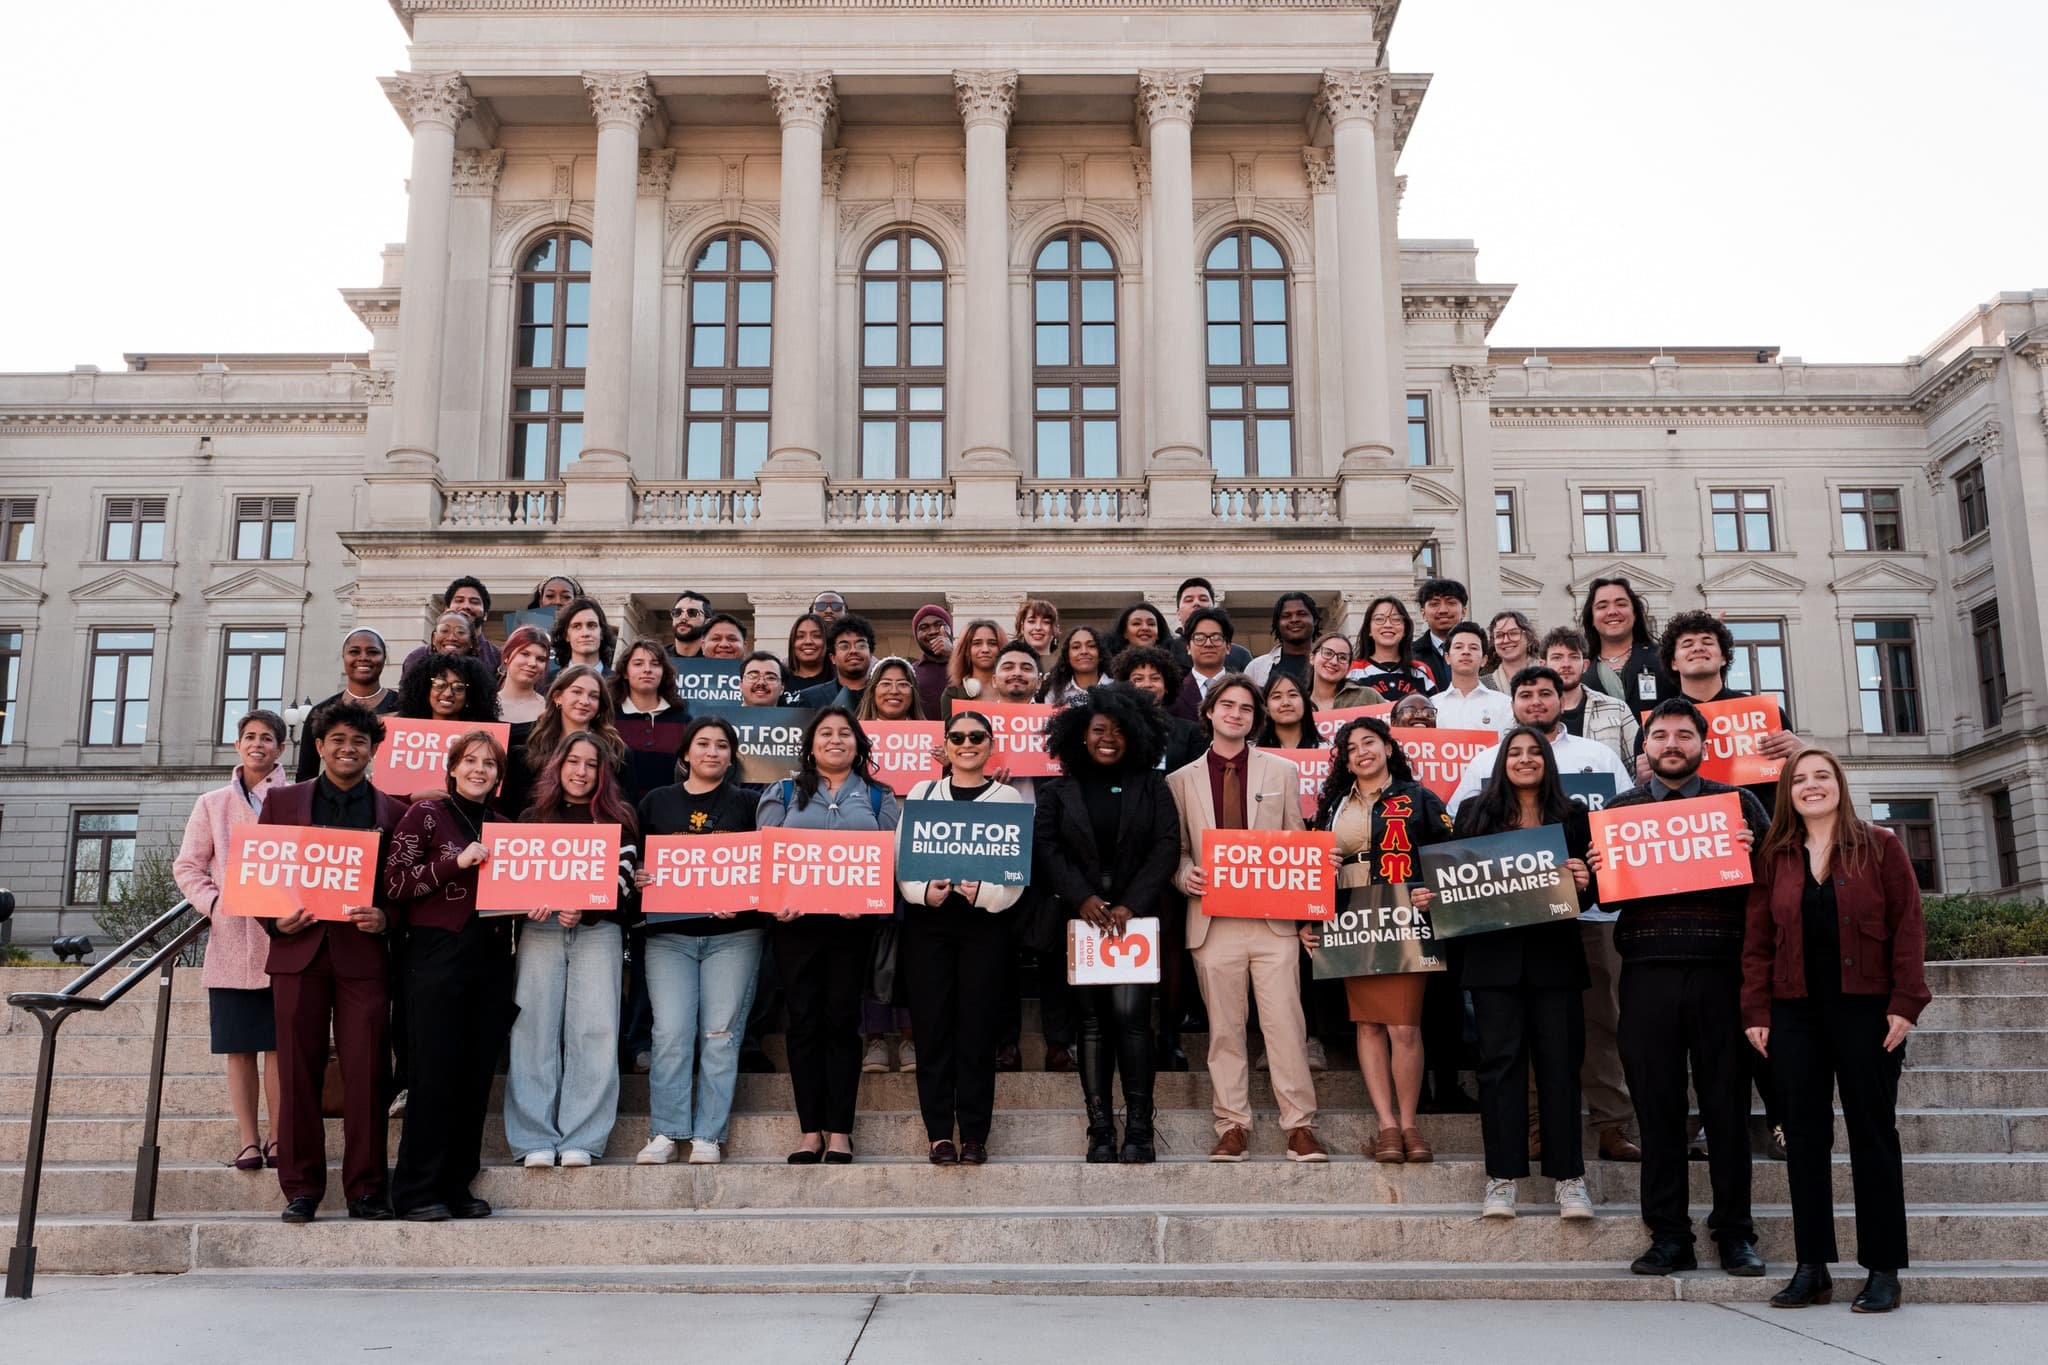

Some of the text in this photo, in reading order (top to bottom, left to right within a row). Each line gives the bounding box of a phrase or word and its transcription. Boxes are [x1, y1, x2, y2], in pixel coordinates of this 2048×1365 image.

[717, 674, 742, 689] FO
[678, 689, 744, 700] ILLIONAIR
[1712, 711, 1767, 735] OUR
[392, 731, 441, 749] FOR
[759, 726, 803, 743] FOR
[885, 733, 933, 750] OUR
[992, 733, 1052, 753] TUR
[738, 743, 803, 756] ONAIRES
[1397, 741, 1436, 759] OR
[871, 752, 932, 771] TURE
[1297, 761, 1330, 776] UR
[1407, 761, 1470, 782] UTU
[913, 821, 1021, 843] NOT FOR
[1604, 811, 1729, 845] FOR OUR
[242, 839, 364, 866] FOR OUR
[494, 838, 607, 857] FOR OUR
[657, 845, 761, 865] FOR OUR
[773, 842, 881, 863] FOR OUR
[912, 841, 1021, 857] BILLIONAIRES
[1214, 844, 1322, 866] FOR OUR
[1607, 833, 1733, 870] FUTURE
[239, 862, 361, 892] FUTURE
[492, 859, 606, 881] FUTURE
[656, 864, 760, 887] FUTURE
[772, 863, 880, 886] FUTURE
[1214, 866, 1321, 891] FUTURE
[1436, 850, 1556, 889] NOT FOR
[1440, 871, 1561, 904] BILLIONAIRES
[1323, 909, 1372, 933] NOT
[1378, 906, 1427, 928] FOR
[1324, 926, 1431, 947] BILLIONAIRES
[1086, 936, 1094, 967] GROUP
[1100, 933, 1151, 968] 3
